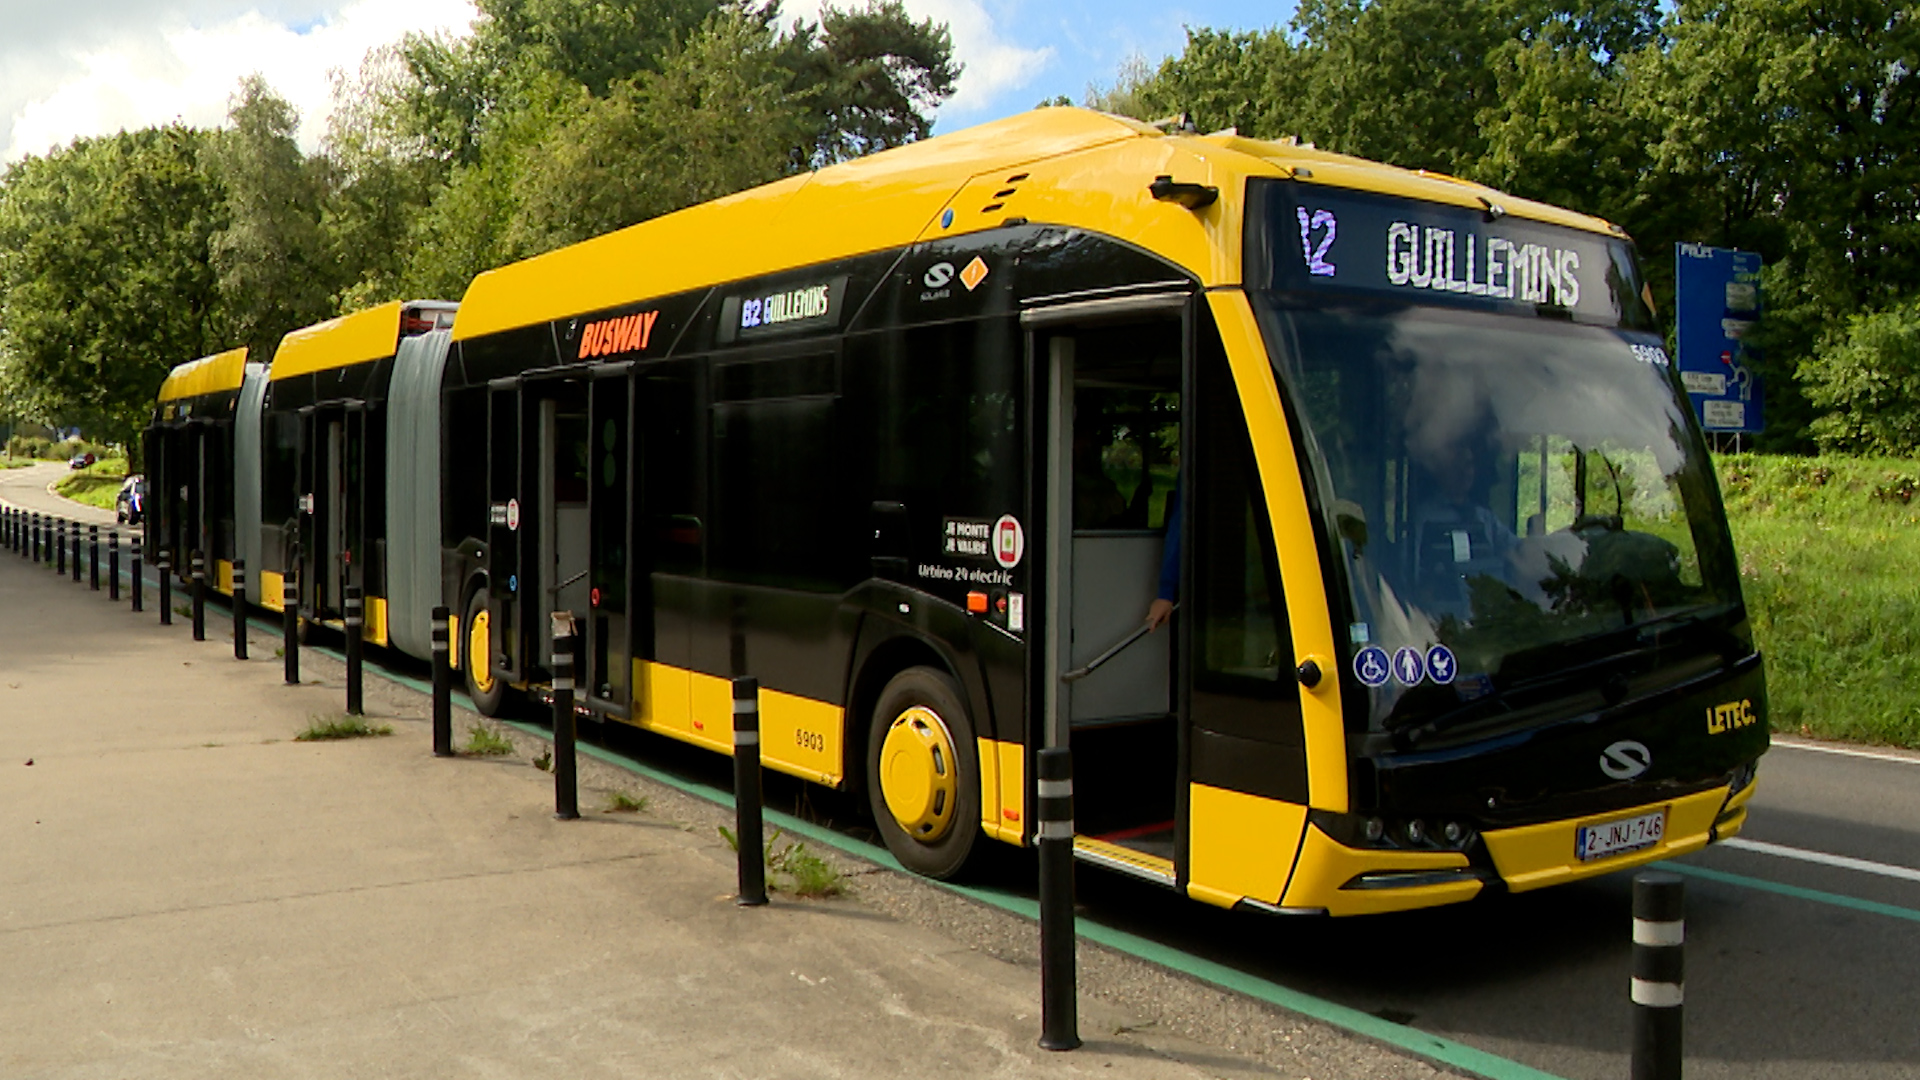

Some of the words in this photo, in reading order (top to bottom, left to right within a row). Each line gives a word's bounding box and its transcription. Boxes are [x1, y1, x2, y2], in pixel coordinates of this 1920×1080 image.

[1387, 221, 1579, 307] GUILLEMINS
[763, 284, 829, 324] GUILLEMINS
[578, 310, 660, 359] BUSWAY
[957, 522, 990, 539] MONTE
[957, 539, 988, 555] VALIDE
[918, 563, 954, 580] Urbino
[969, 567, 1014, 586] electric
[796, 728, 824, 752] 5903
[1588, 816, 1662, 851] 2-JNJ-746
